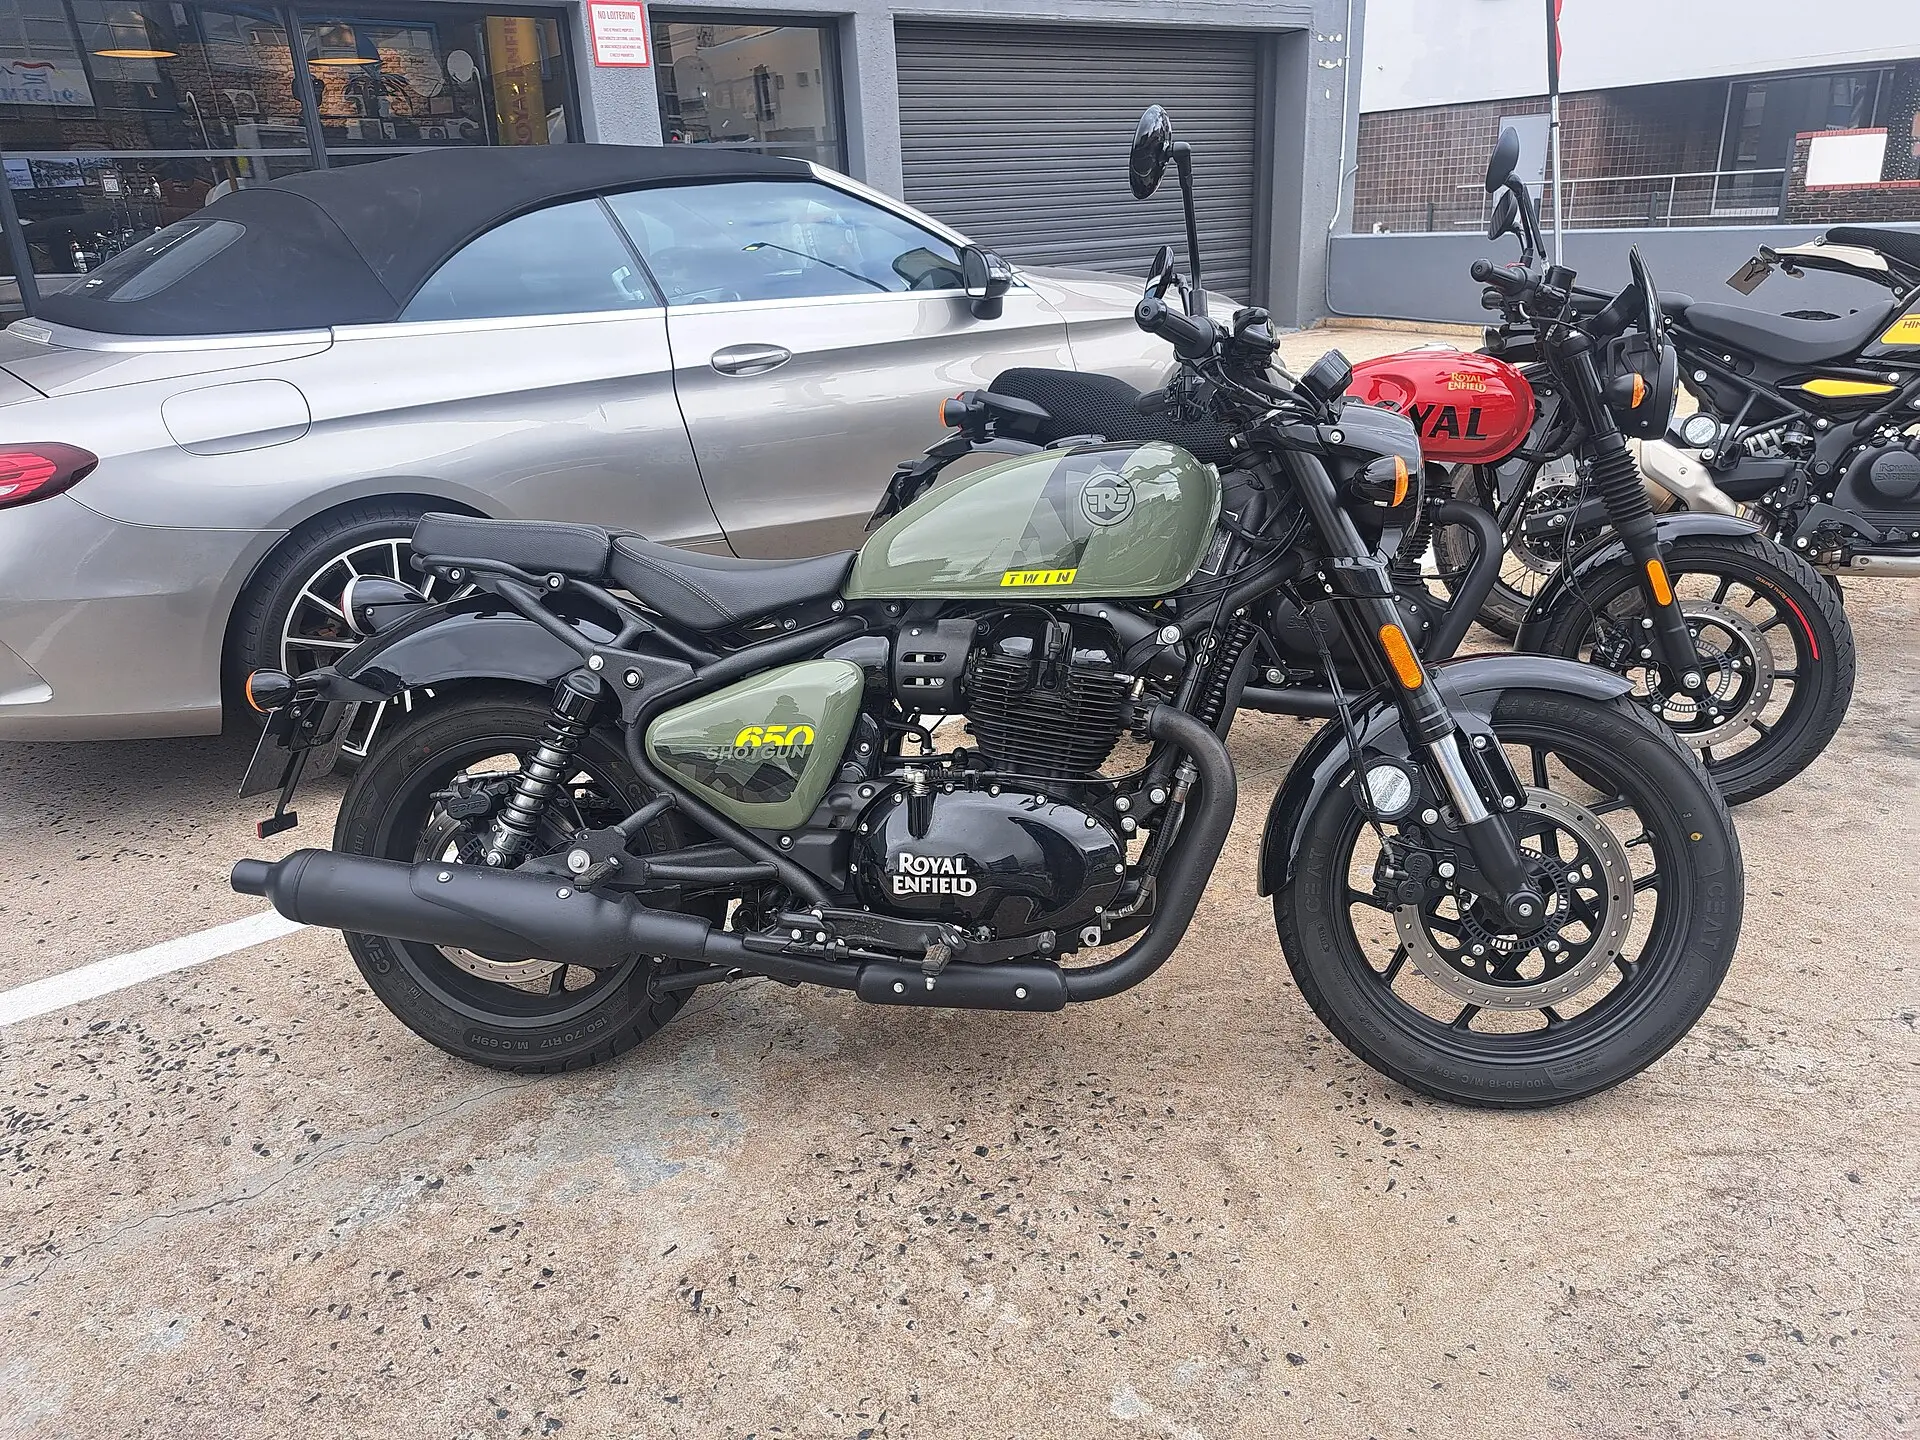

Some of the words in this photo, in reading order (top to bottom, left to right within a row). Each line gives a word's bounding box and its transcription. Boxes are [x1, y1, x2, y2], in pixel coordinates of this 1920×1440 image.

[597, 10, 606, 20] NO
[607, 11, 636, 20] LOITERING
[1451, 372, 1483, 383] ROYAL
[1447, 382, 1487, 393] ENFIELD
[1378, 402, 1488, 441] YAL
[1008, 571, 1071, 585] TWIN
[735, 725, 816, 747] 650
[706, 744, 807, 760] SHOTGUN
[899, 852, 968, 876] ROYAL
[892, 875, 978, 897] ENFIELD
[1303, 846, 1327, 913] CEAT
[564, 1015, 608, 1043] 150/70
[471, 1034, 501, 1049] 69H
[501, 1038, 529, 1050] M/C
[540, 1035, 563, 1049] R17
